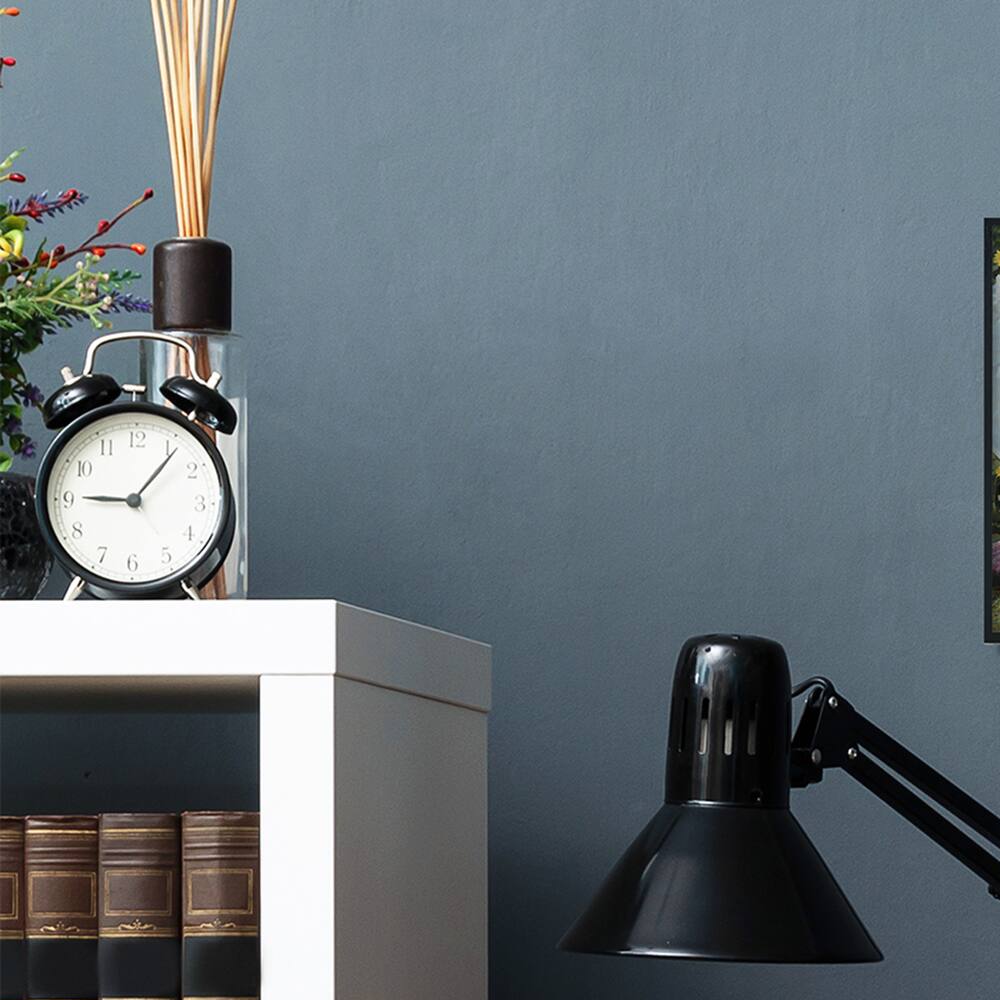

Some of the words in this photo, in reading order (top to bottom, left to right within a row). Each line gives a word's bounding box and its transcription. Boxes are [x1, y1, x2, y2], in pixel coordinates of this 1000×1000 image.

[100, 439, 113, 456] 11
[129, 431, 146, 448] 12
[165, 439, 171, 456] 1
[77, 460, 92, 477] 10
[187, 462, 198, 479] 2
[63, 490, 75, 508] 9
[194, 495, 206, 512] 3
[72, 521, 83, 538] 8
[182, 525, 194, 541] 4
[97, 546, 108, 563] 7
[127, 554, 138, 571] 6
[161, 546, 172, 563] 5
